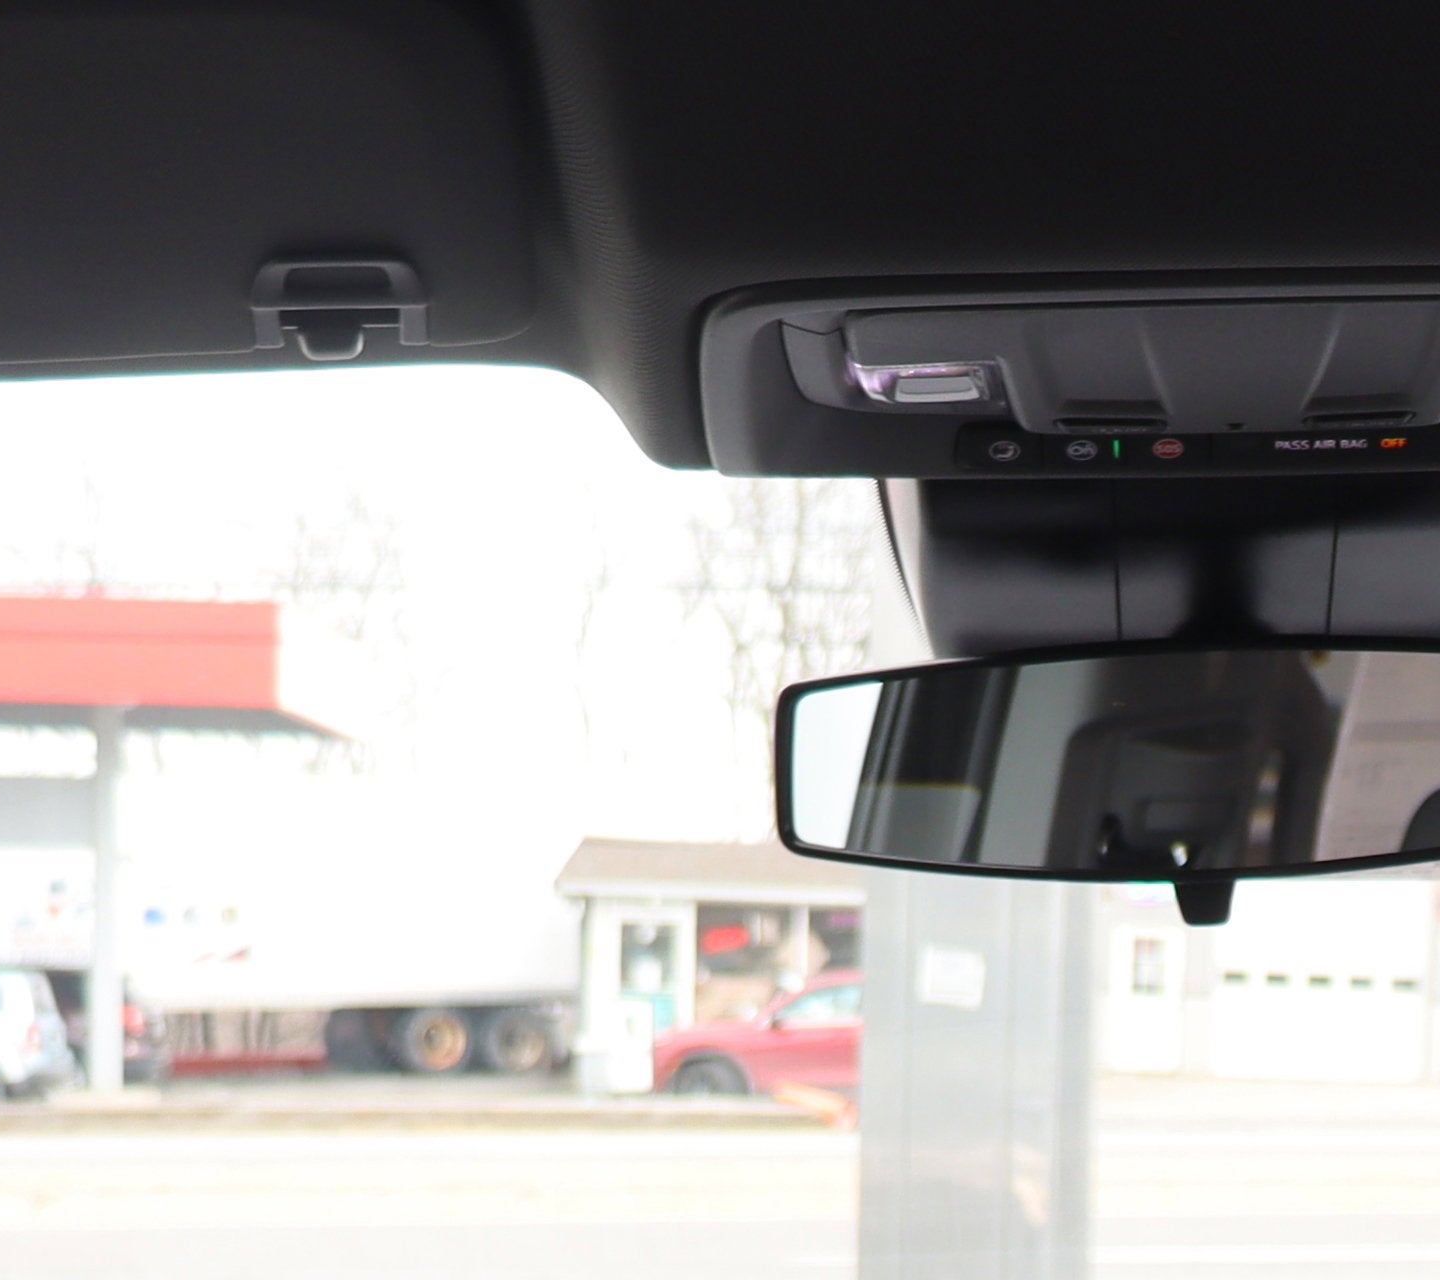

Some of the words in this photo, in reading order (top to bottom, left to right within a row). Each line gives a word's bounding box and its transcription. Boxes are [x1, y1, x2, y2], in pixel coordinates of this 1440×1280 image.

[1275, 440, 1310, 450] PASS
[1313, 439, 1337, 449] AIR
[1340, 439, 1368, 449] BAG
[1380, 438, 1408, 449] OFF
